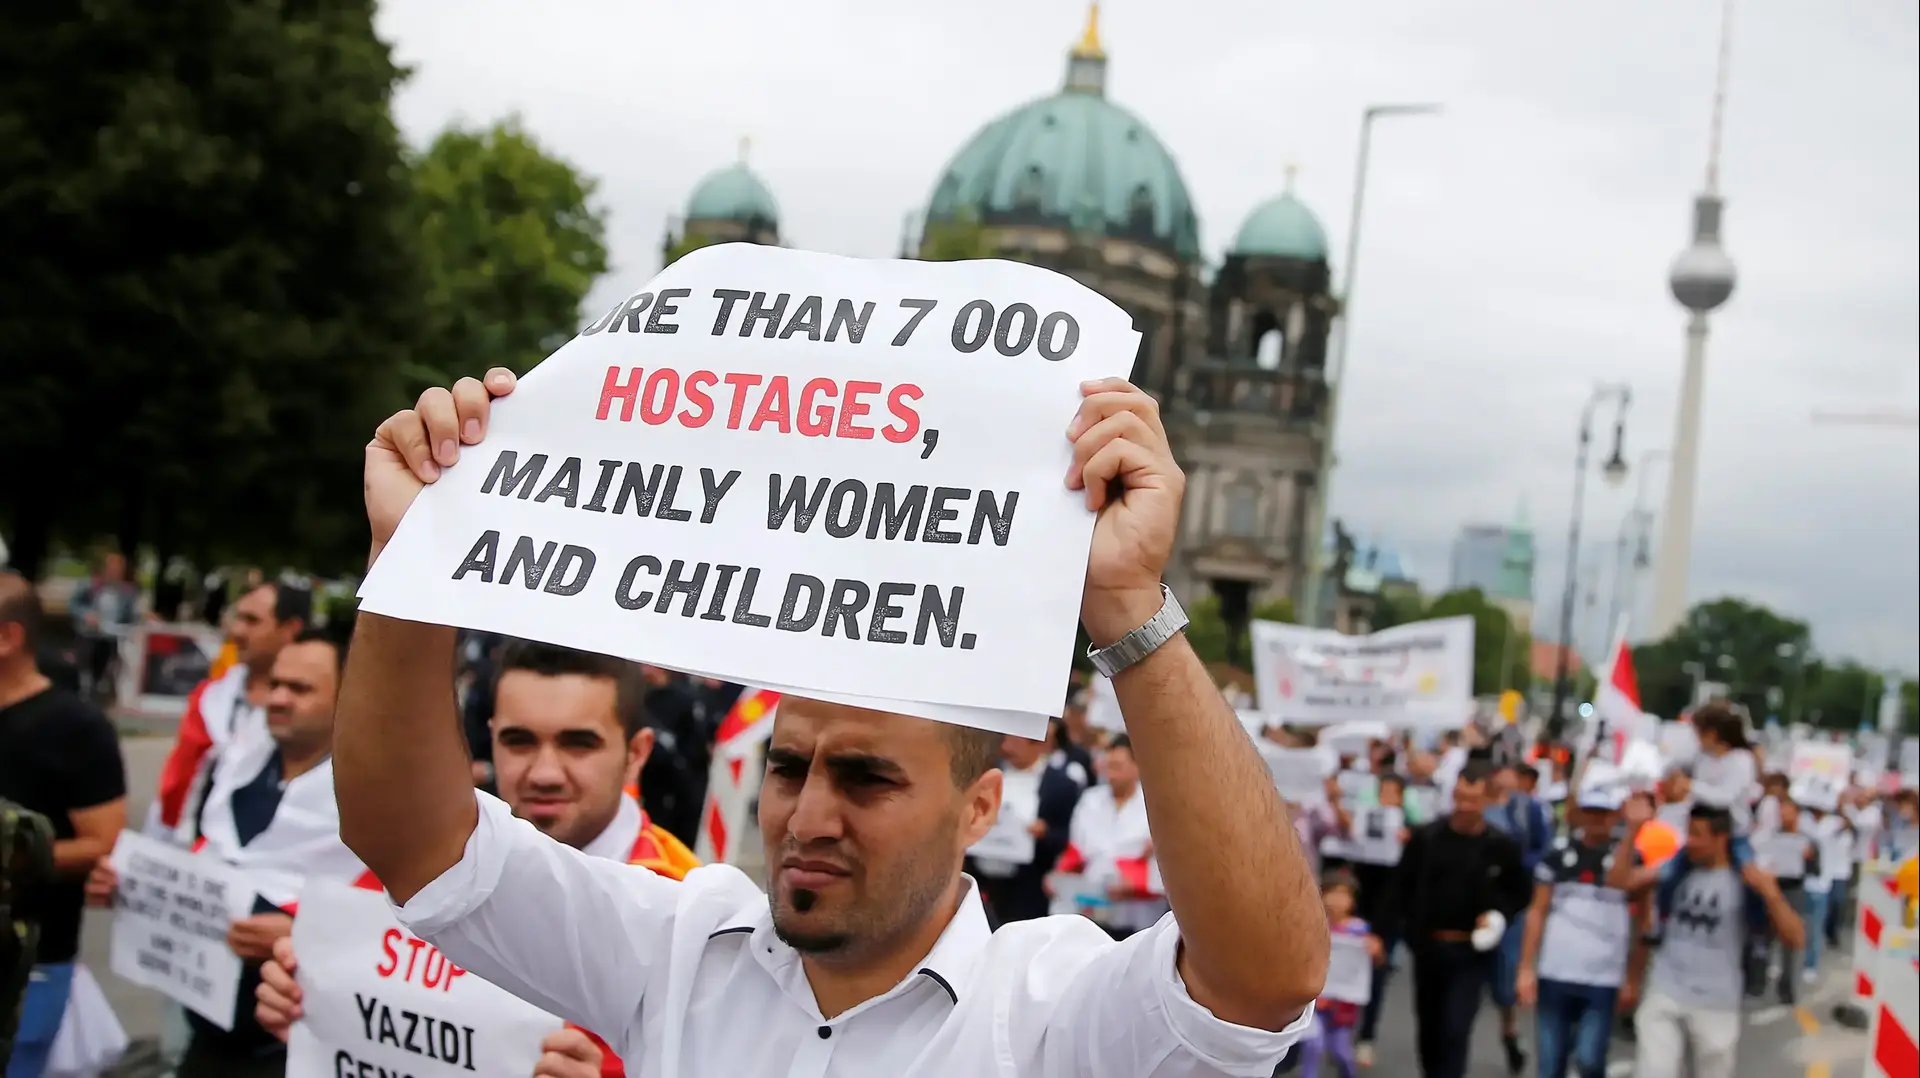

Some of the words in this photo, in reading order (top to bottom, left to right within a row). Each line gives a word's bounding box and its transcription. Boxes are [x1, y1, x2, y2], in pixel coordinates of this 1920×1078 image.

[711, 288, 877, 345] THAN
[891, 298, 939, 347] 7
[951, 299, 1081, 362] 000
[595, 365, 940, 460] HOSTAGES,
[480, 450, 742, 525] MAINLY
[767, 473, 1020, 547] WOMEN
[451, 529, 597, 597] AND
[614, 554, 978, 651] CHILDREN.
[376, 928, 467, 992] STOP
[354, 992, 477, 1072] YAZIDI
